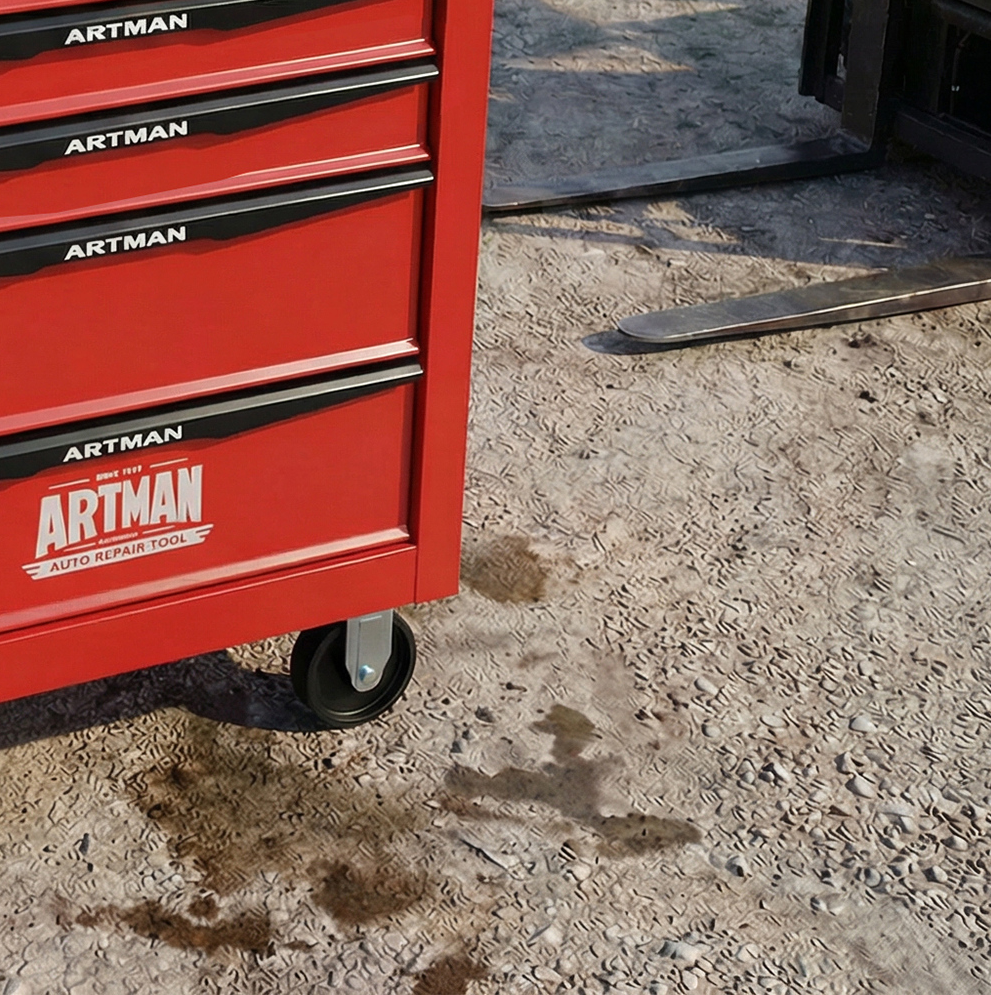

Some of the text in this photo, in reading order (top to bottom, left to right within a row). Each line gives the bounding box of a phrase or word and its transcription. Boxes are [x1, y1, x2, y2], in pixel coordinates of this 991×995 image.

[64, 13, 188, 45] ARTMAN
[64, 120, 189, 156] ARTMAN
[64, 225, 187, 261] ARTMAN
[62, 425, 183, 463] ARTMAN
[34, 464, 204, 560] ARTMAN
[49, 555, 90, 573] AUTO
[95, 542, 145, 563] REPAIR
[151, 533, 187, 550] TOOL
